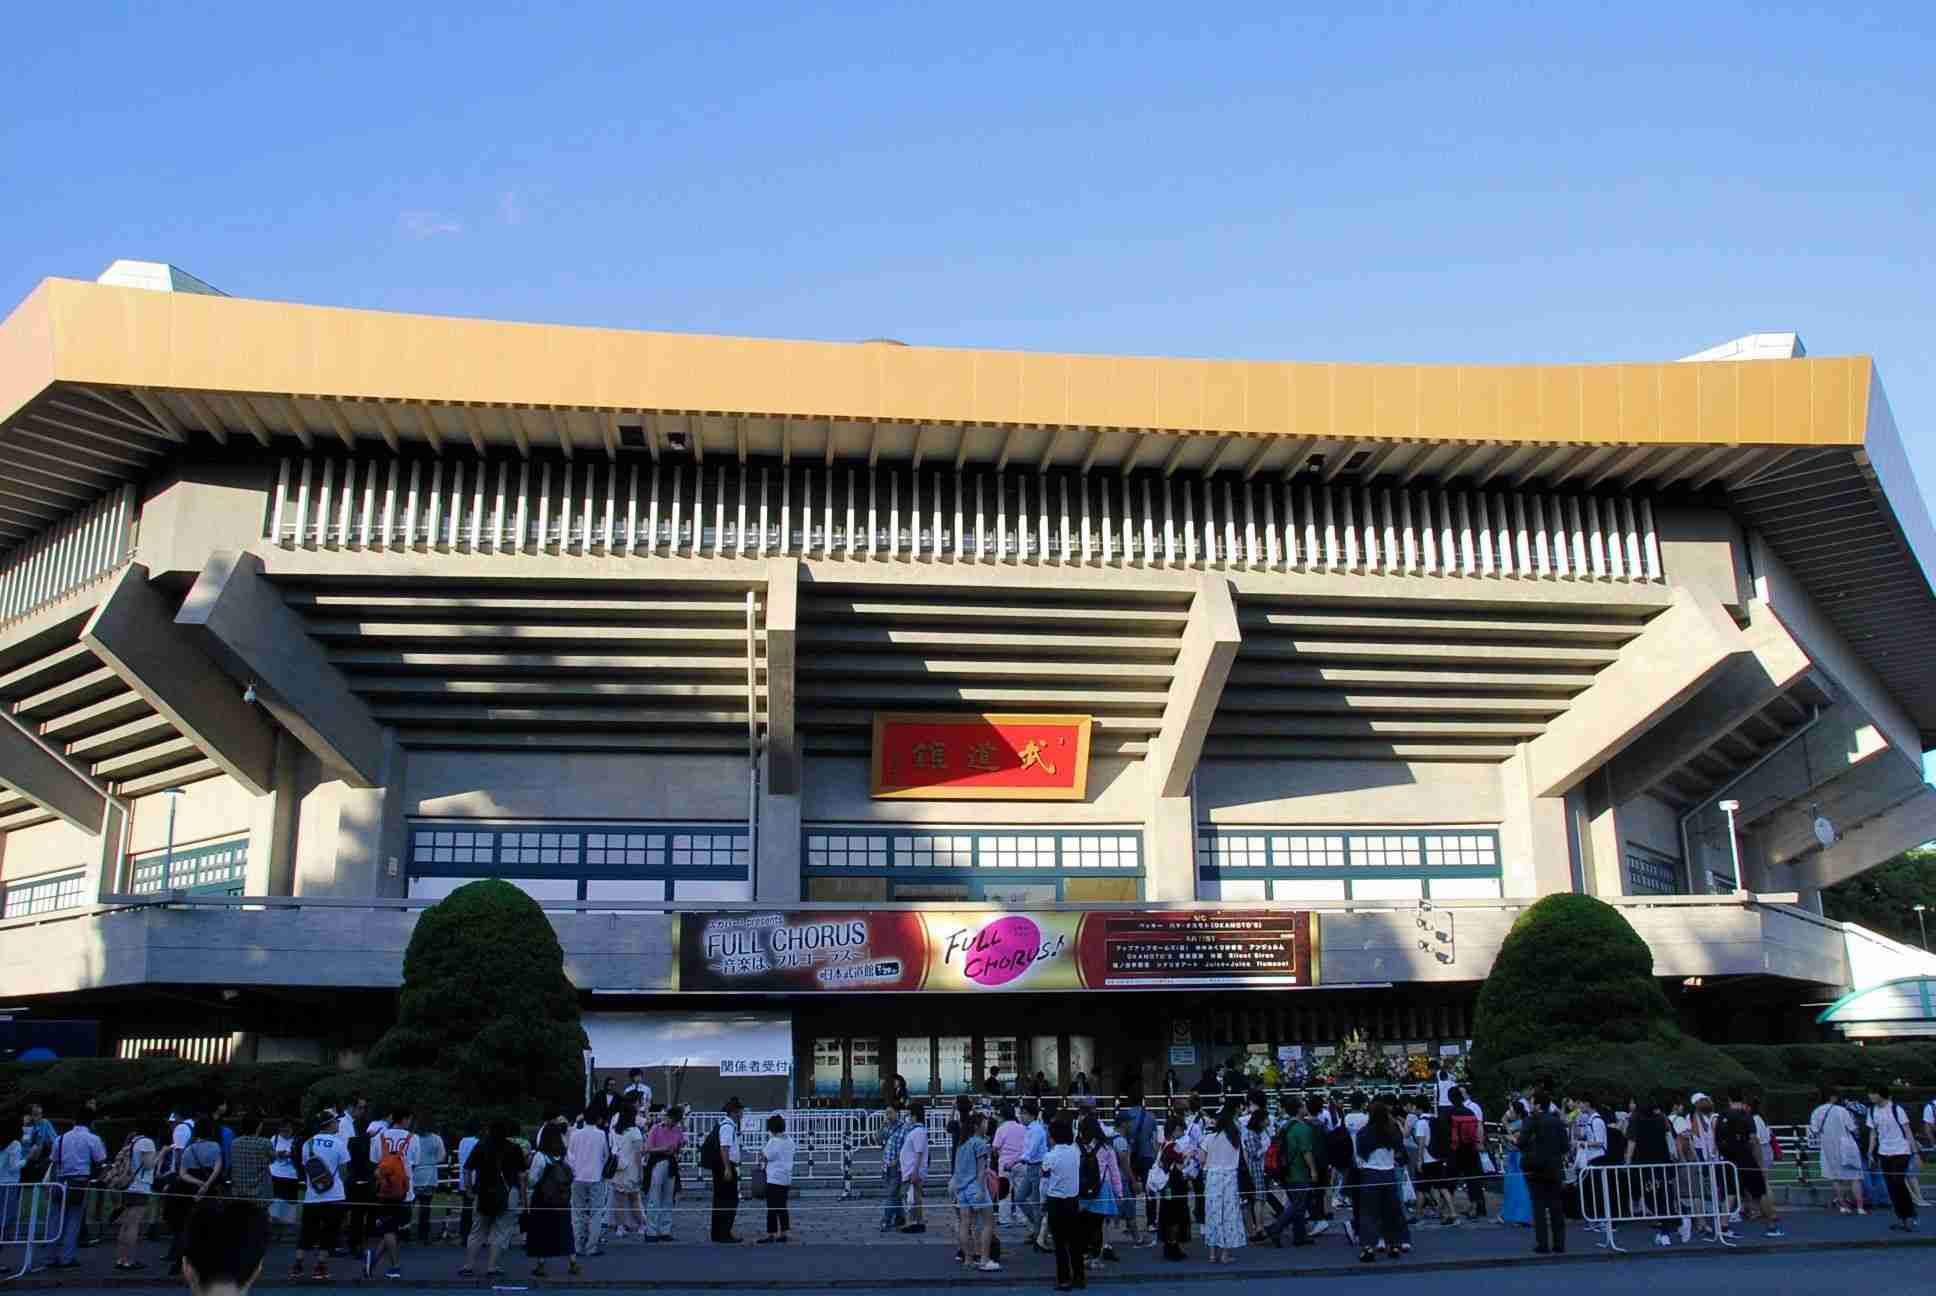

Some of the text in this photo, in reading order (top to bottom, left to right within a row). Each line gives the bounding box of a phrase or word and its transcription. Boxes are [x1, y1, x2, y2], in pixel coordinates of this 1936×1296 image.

[708, 922, 865, 957] FULL CHORUS
[945, 929, 1002, 964] FULL
[720, 1059, 788, 1073] 関係者受付
